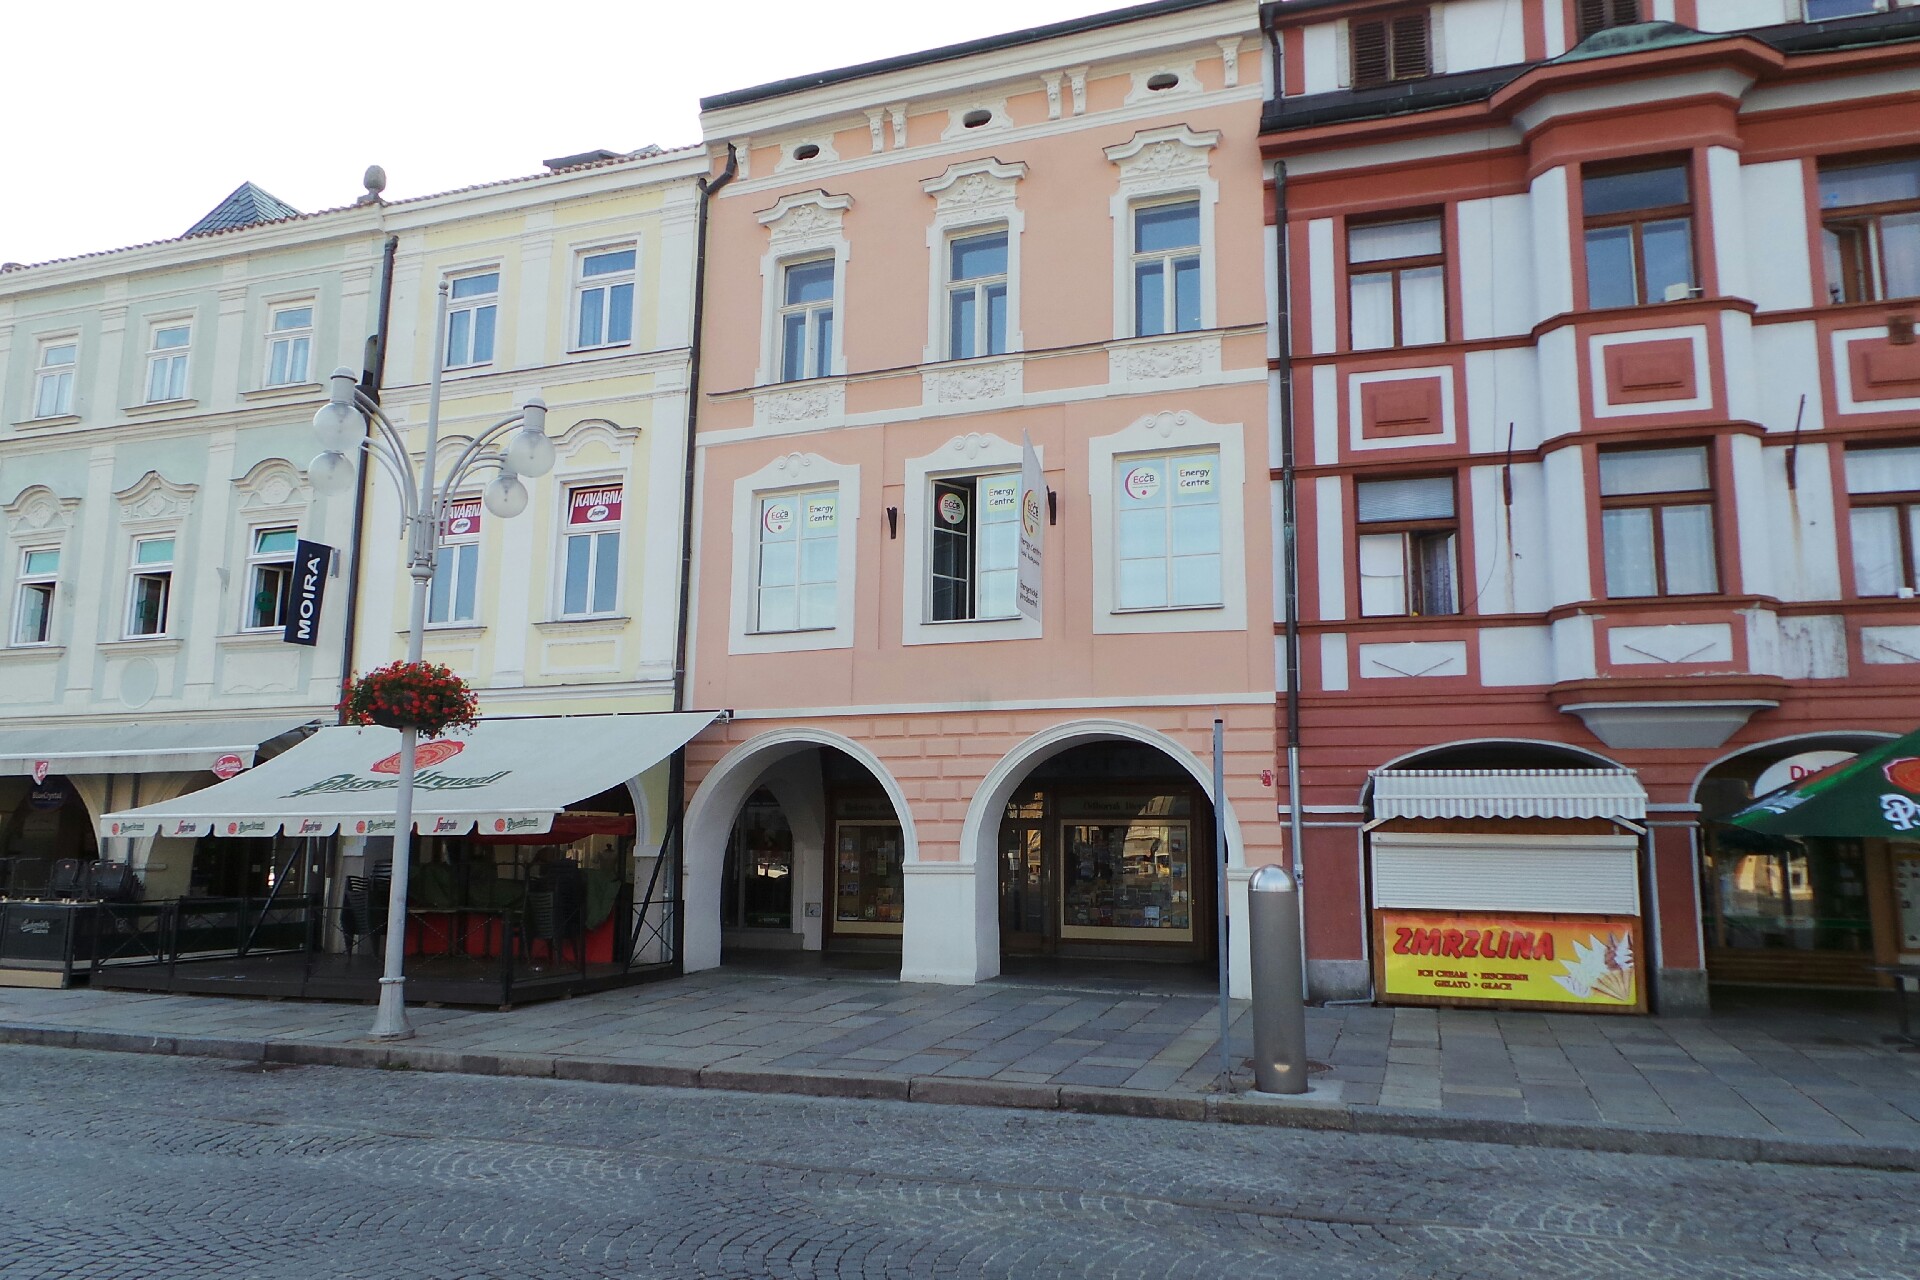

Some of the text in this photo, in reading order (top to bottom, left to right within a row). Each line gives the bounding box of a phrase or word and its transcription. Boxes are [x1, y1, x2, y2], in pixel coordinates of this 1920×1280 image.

[989, 488, 1015, 497] Energy
[989, 498, 1015, 506] Centre
[810, 505, 834, 514] Energy
[297, 557, 321, 639] MOIRA
[277, 774, 400, 800] Pilsne
[1880, 793, 1920, 831] P
[1392, 927, 1555, 961] ZMRZLINA
[1435, 970, 1468, 979] CREAM
[1434, 980, 1513, 990] GELATO GLACE
